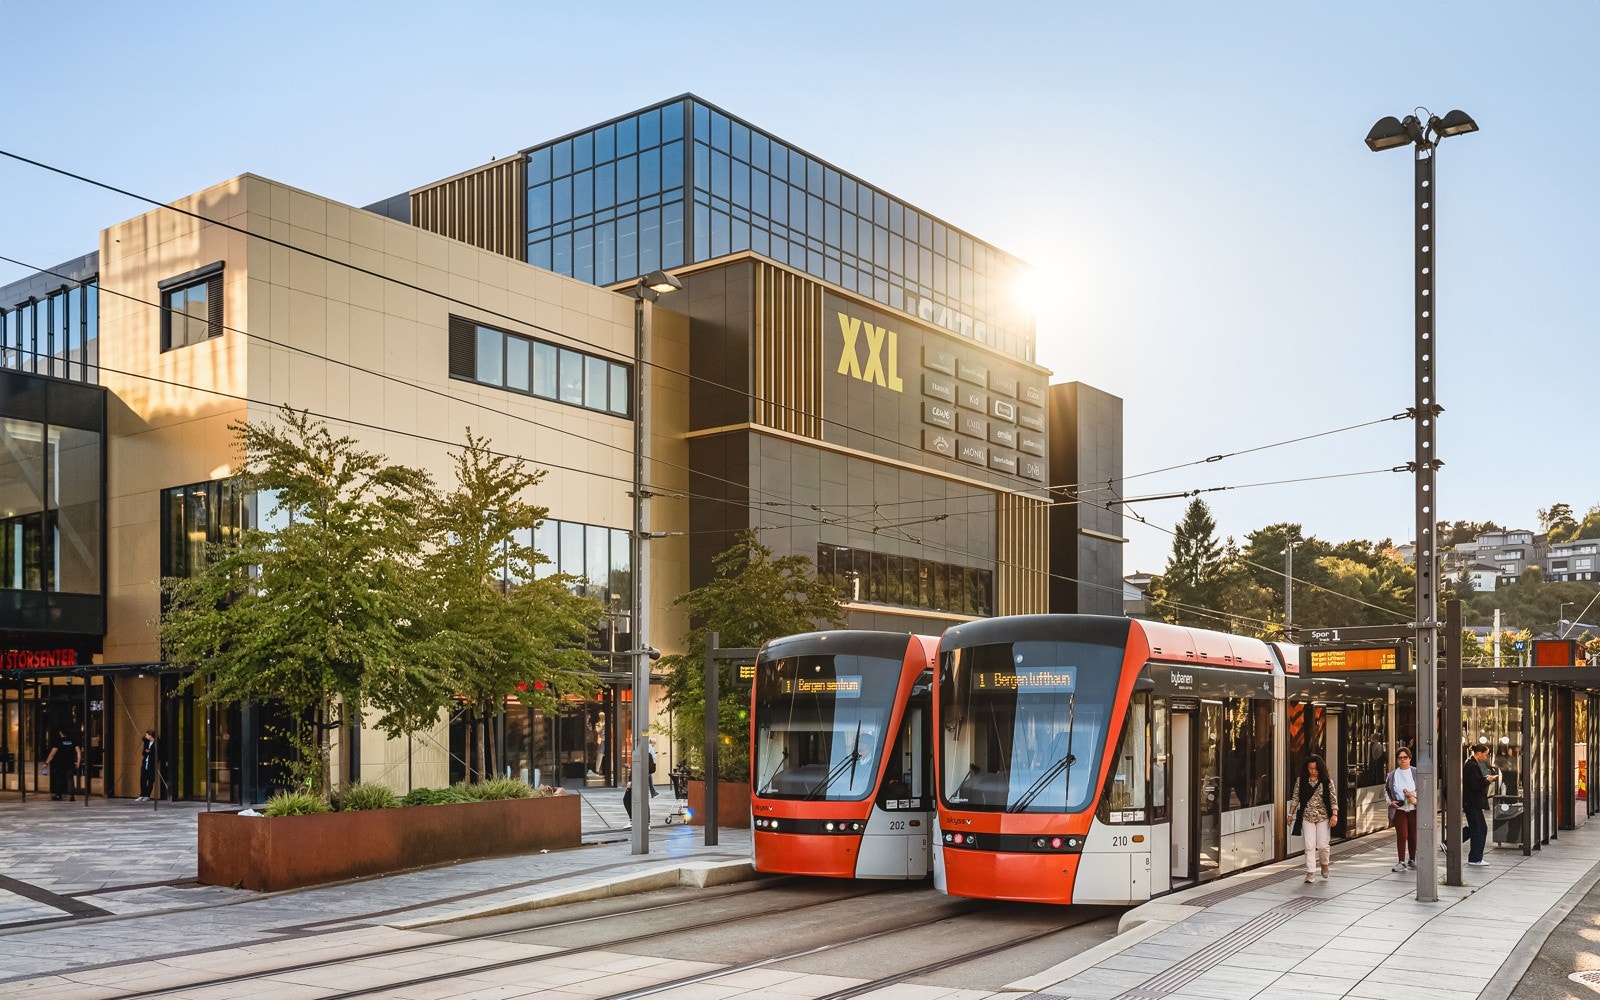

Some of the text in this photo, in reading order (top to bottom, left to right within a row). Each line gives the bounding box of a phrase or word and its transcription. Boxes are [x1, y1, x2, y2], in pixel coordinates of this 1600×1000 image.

[837, 311, 903, 393] XXL
[932, 406, 950, 420] cewe
[1311, 630, 1340, 641] Spor 1
[6, 649, 75, 669] STORSENTER
[798, 678, 826, 693] Bergen
[826, 677, 859, 691] sentrum
[980, 673, 986, 688] 1
[994, 672, 1028, 689] Bergen
[1170, 671, 1193, 686] bybanen
[890, 821, 905, 830] 202
[946, 816, 966, 825] skyss
[1112, 836, 1128, 847] 210
